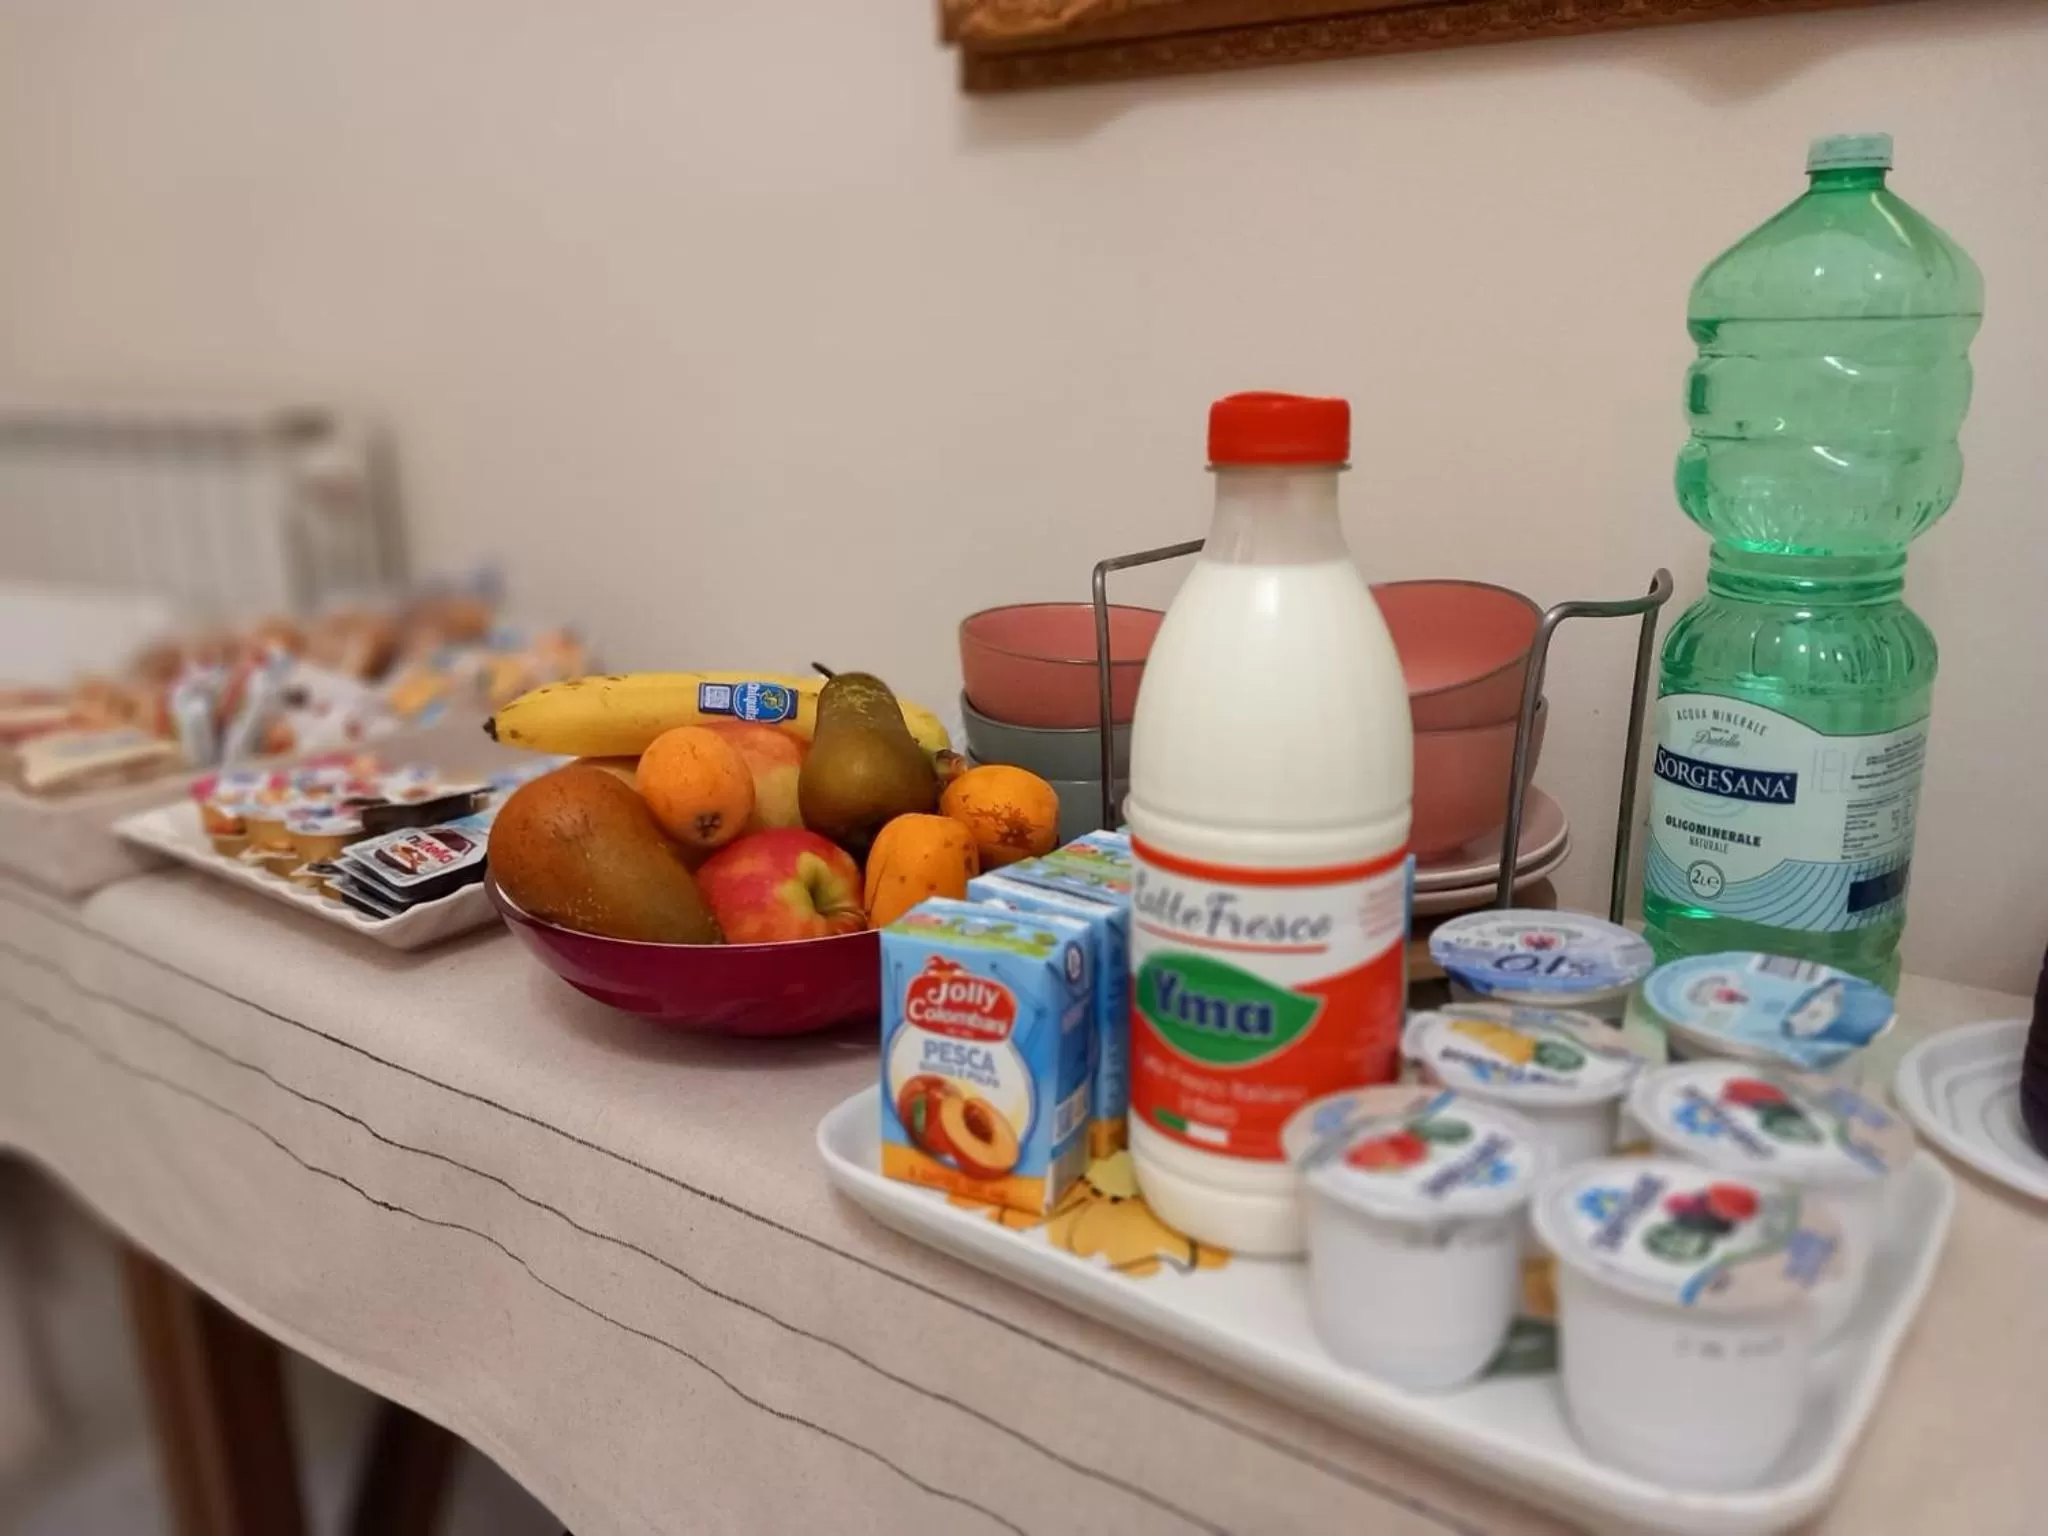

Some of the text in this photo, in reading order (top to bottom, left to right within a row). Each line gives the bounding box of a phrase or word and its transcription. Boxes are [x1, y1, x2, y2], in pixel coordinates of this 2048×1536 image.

[1676, 708, 1707, 721] ACQUA
[1711, 709, 1769, 736] MINERALE
[1665, 815, 1762, 848] OLIGOMINERALE
[1689, 836, 1729, 855] NATURALE
[1204, 890, 1334, 943] Fresco
[925, 981, 1000, 1014] Jolly
[1155, 967, 1275, 1037] Yma
[922, 1039, 998, 1075] PESCA
